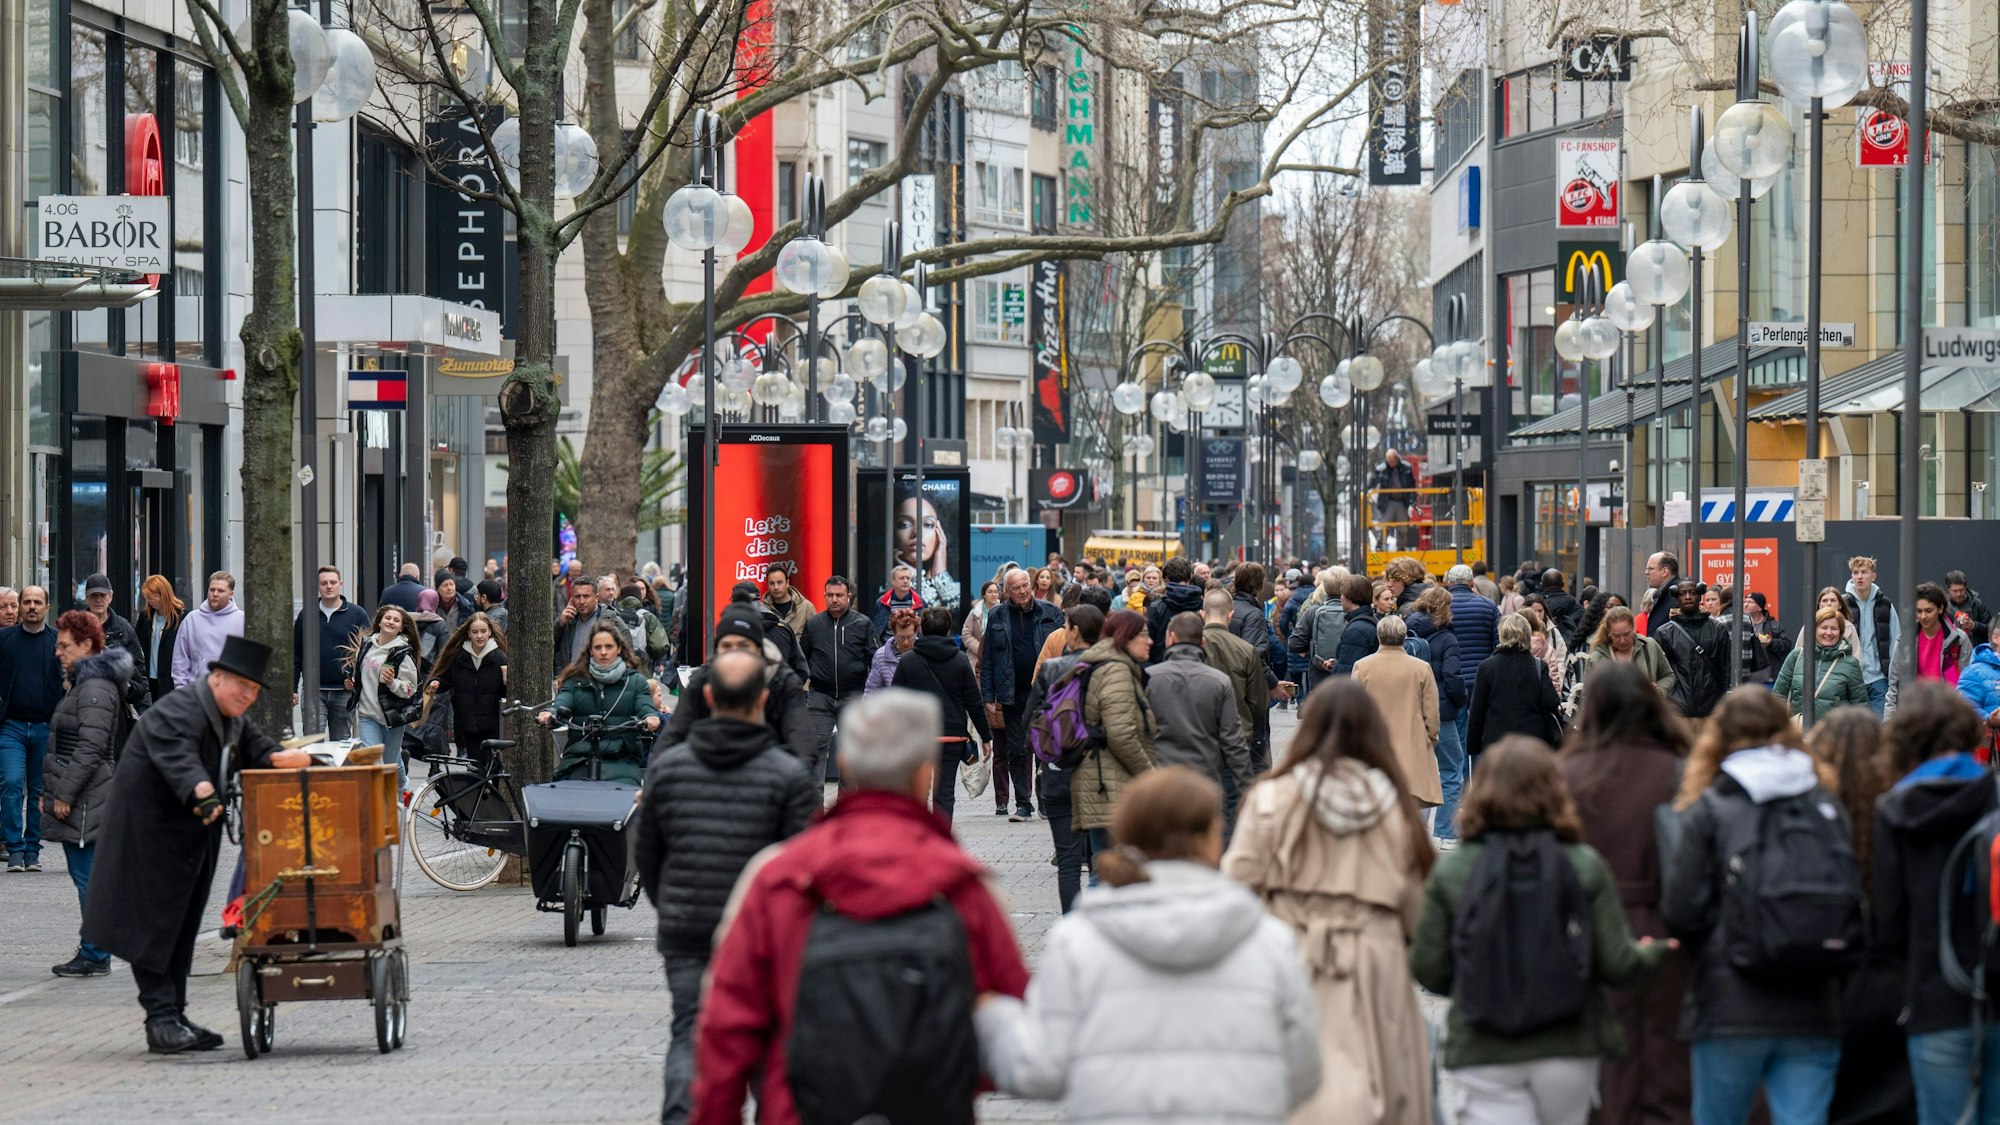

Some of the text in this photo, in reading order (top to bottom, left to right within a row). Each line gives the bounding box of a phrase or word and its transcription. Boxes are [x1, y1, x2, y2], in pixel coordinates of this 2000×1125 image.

[1571, 44, 1622, 73] C&A
[1066, 0, 1093, 223] ICHMANN
[1560, 142, 1617, 152] FC-FANSHOP
[45, 203, 79, 216] 4.OG
[1595, 216, 1617, 226] ETAGE
[45, 220, 161, 250] BABOR
[125, 256, 161, 267] SPA
[1037, 306, 1060, 373] Pizza
[1762, 327, 1842, 345] Perlengächen
[1433, 421, 1472, 429] SIDESEP
[921, 483, 957, 491] CHANEL
[746, 537, 789, 558] date
[1707, 559, 1725, 568] NEU
